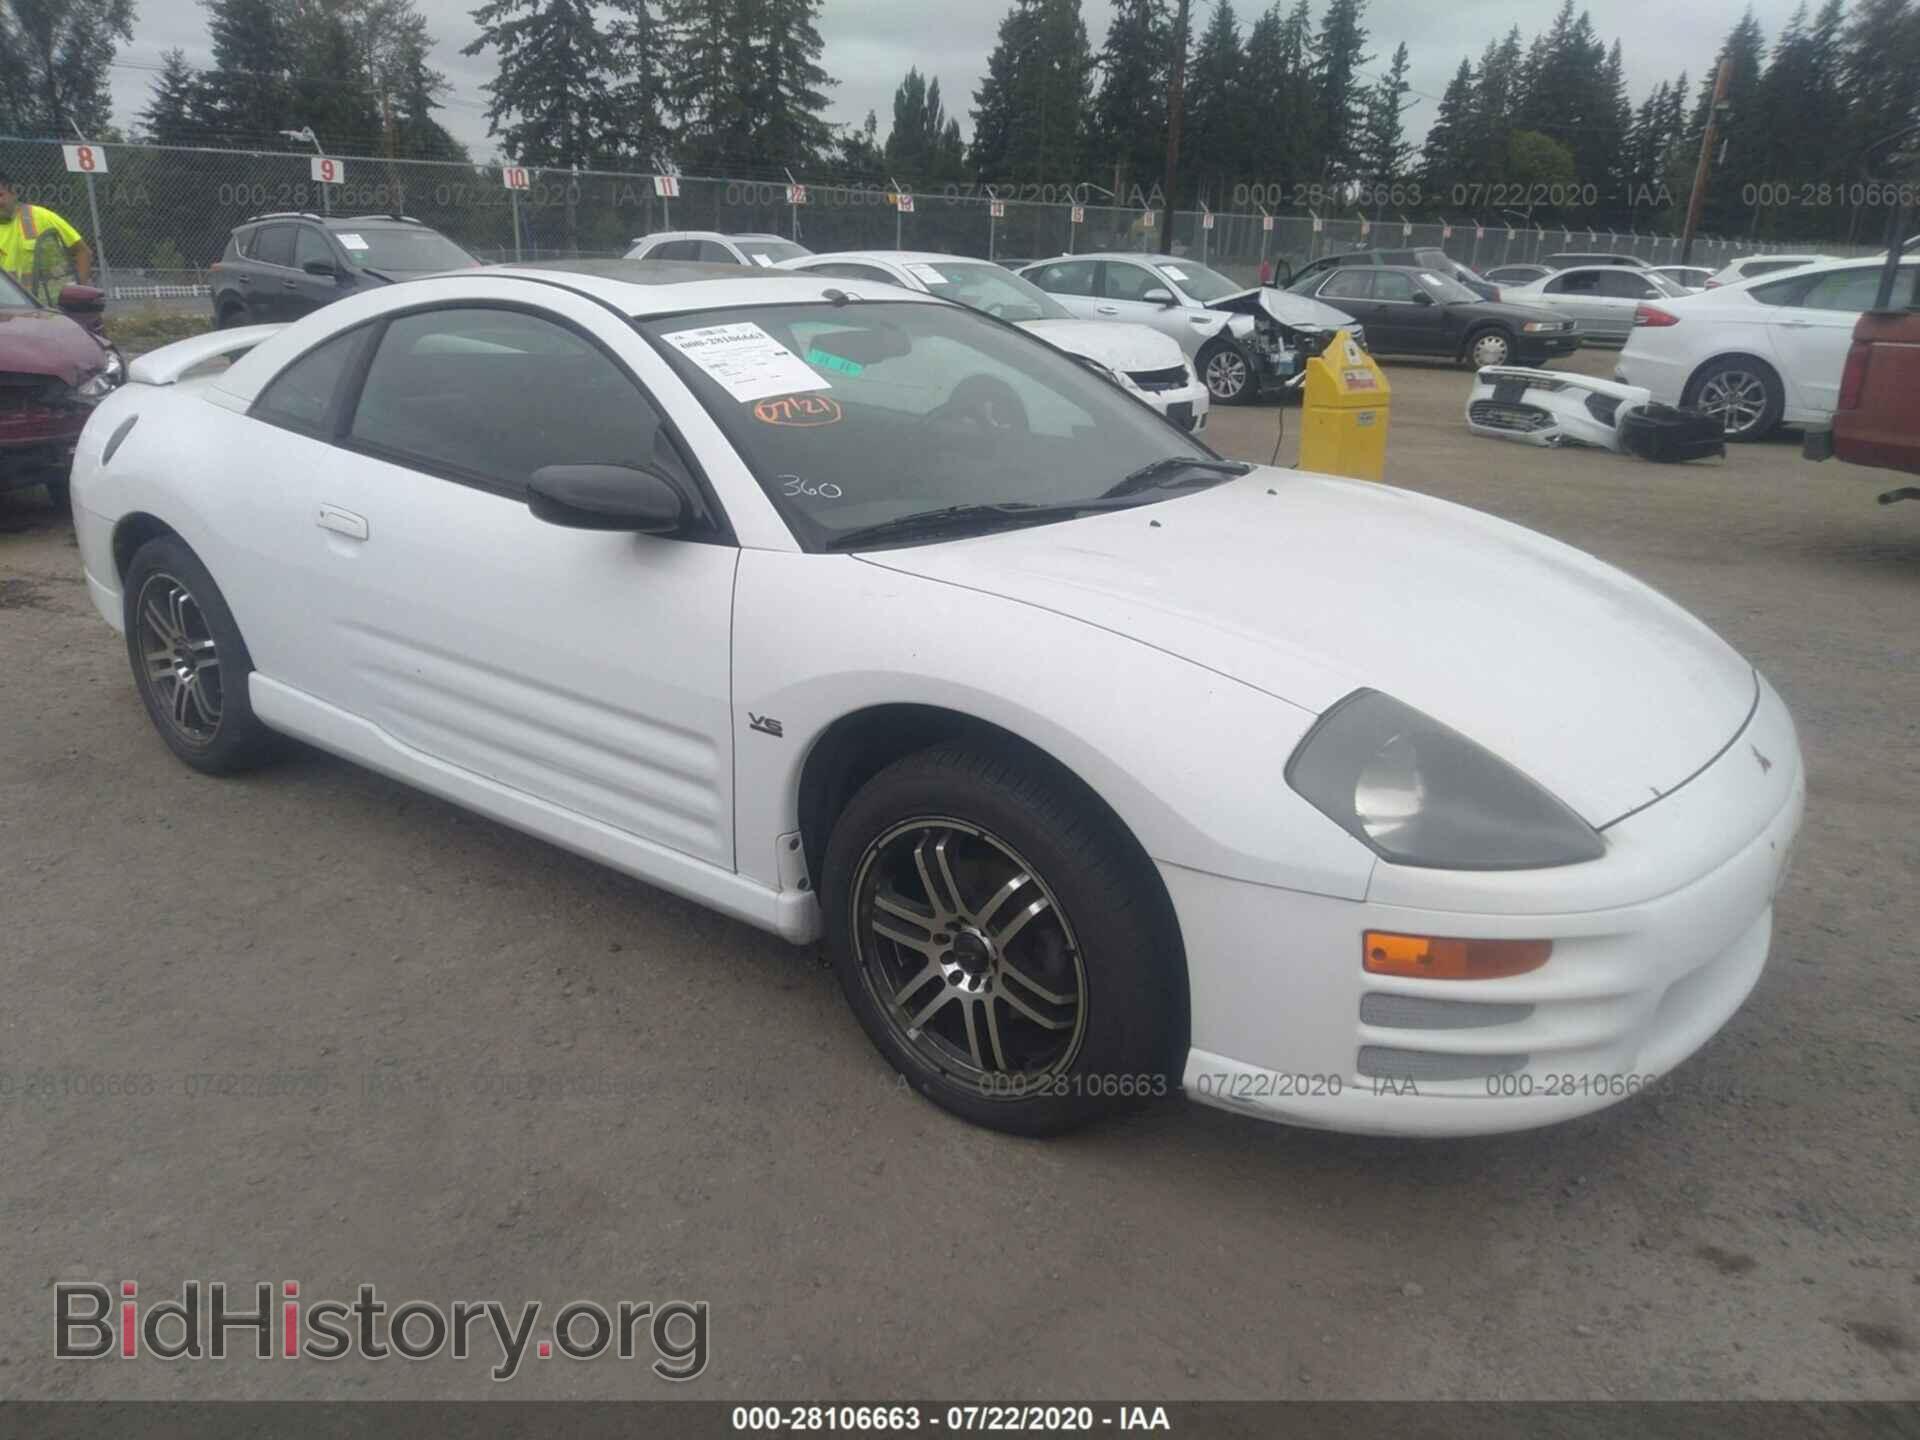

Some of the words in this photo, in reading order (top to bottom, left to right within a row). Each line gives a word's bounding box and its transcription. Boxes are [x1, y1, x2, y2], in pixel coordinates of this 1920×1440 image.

[78, 146, 95, 171] 8
[321, 158, 335, 181] 9
[507, 168, 527, 188] 10
[661, 177, 673, 197] 11
[777, 474, 842, 498] 360
